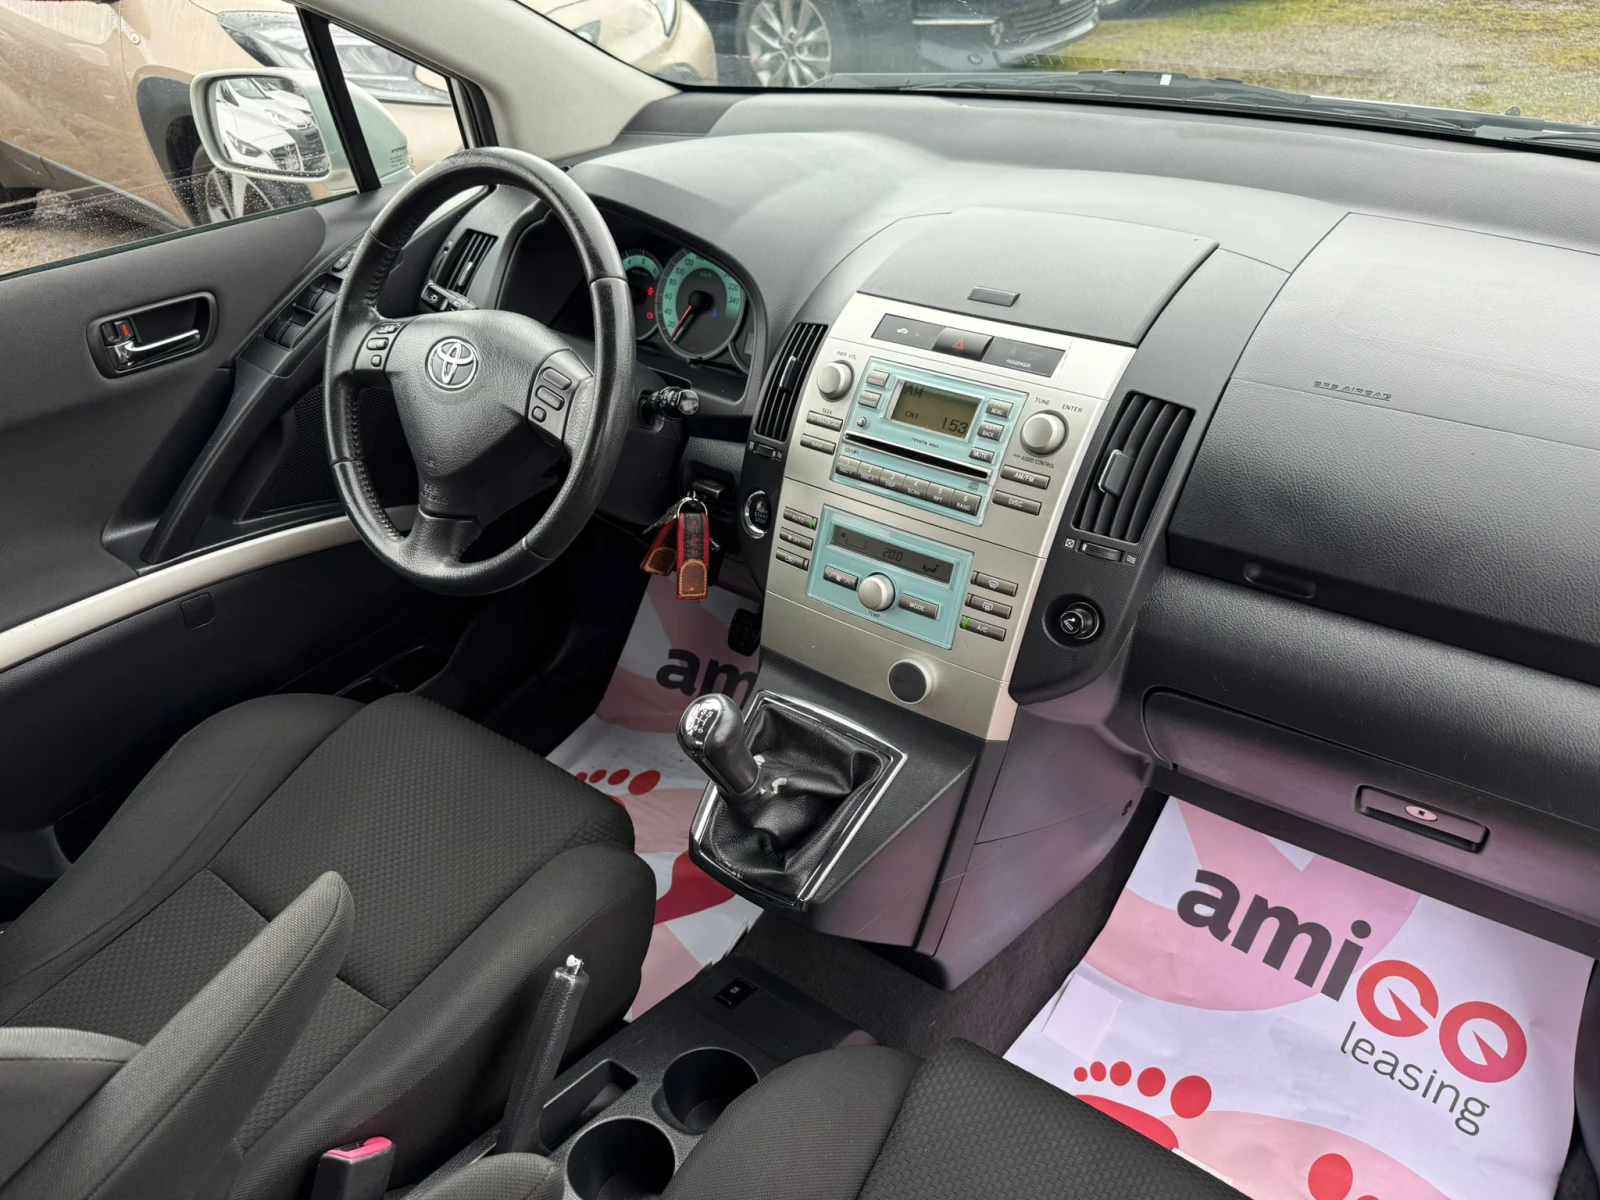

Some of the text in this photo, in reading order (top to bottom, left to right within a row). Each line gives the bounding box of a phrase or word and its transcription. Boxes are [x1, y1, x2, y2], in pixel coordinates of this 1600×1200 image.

[685, 258, 694, 267] 120
[675, 267, 685, 276] 100
[669, 279, 677, 287] 80
[728, 284, 739, 292] 220
[664, 293, 672, 301] 60
[728, 297, 740, 305] 240
[664, 308, 672, 316] 40
[667, 320, 675, 328] 20
[1006, 359, 1032, 368] PASSENGER
[905, 385, 924, 398] AM
[1034, 397, 1050, 406] TUNE
[1062, 404, 1083, 413] ENTER
[941, 417, 969, 435] 153
[982, 430, 994, 438] BACK
[973, 451, 988, 460] MUTE
[1021, 455, 1035, 464] AUDIO
[1035, 459, 1055, 469] CONTROL
[1014, 472, 1035, 483] AM/FM
[907, 488, 921, 496] SCAN
[956, 503, 971, 511] RAND
[1008, 498, 1023, 508] DISC
[792, 514, 805, 523] AUTO
[909, 602, 925, 611] MODE
[868, 610, 881, 618] TEMP
[977, 625, 988, 633] A/C
[1340, 1021, 1490, 1136] leasing
